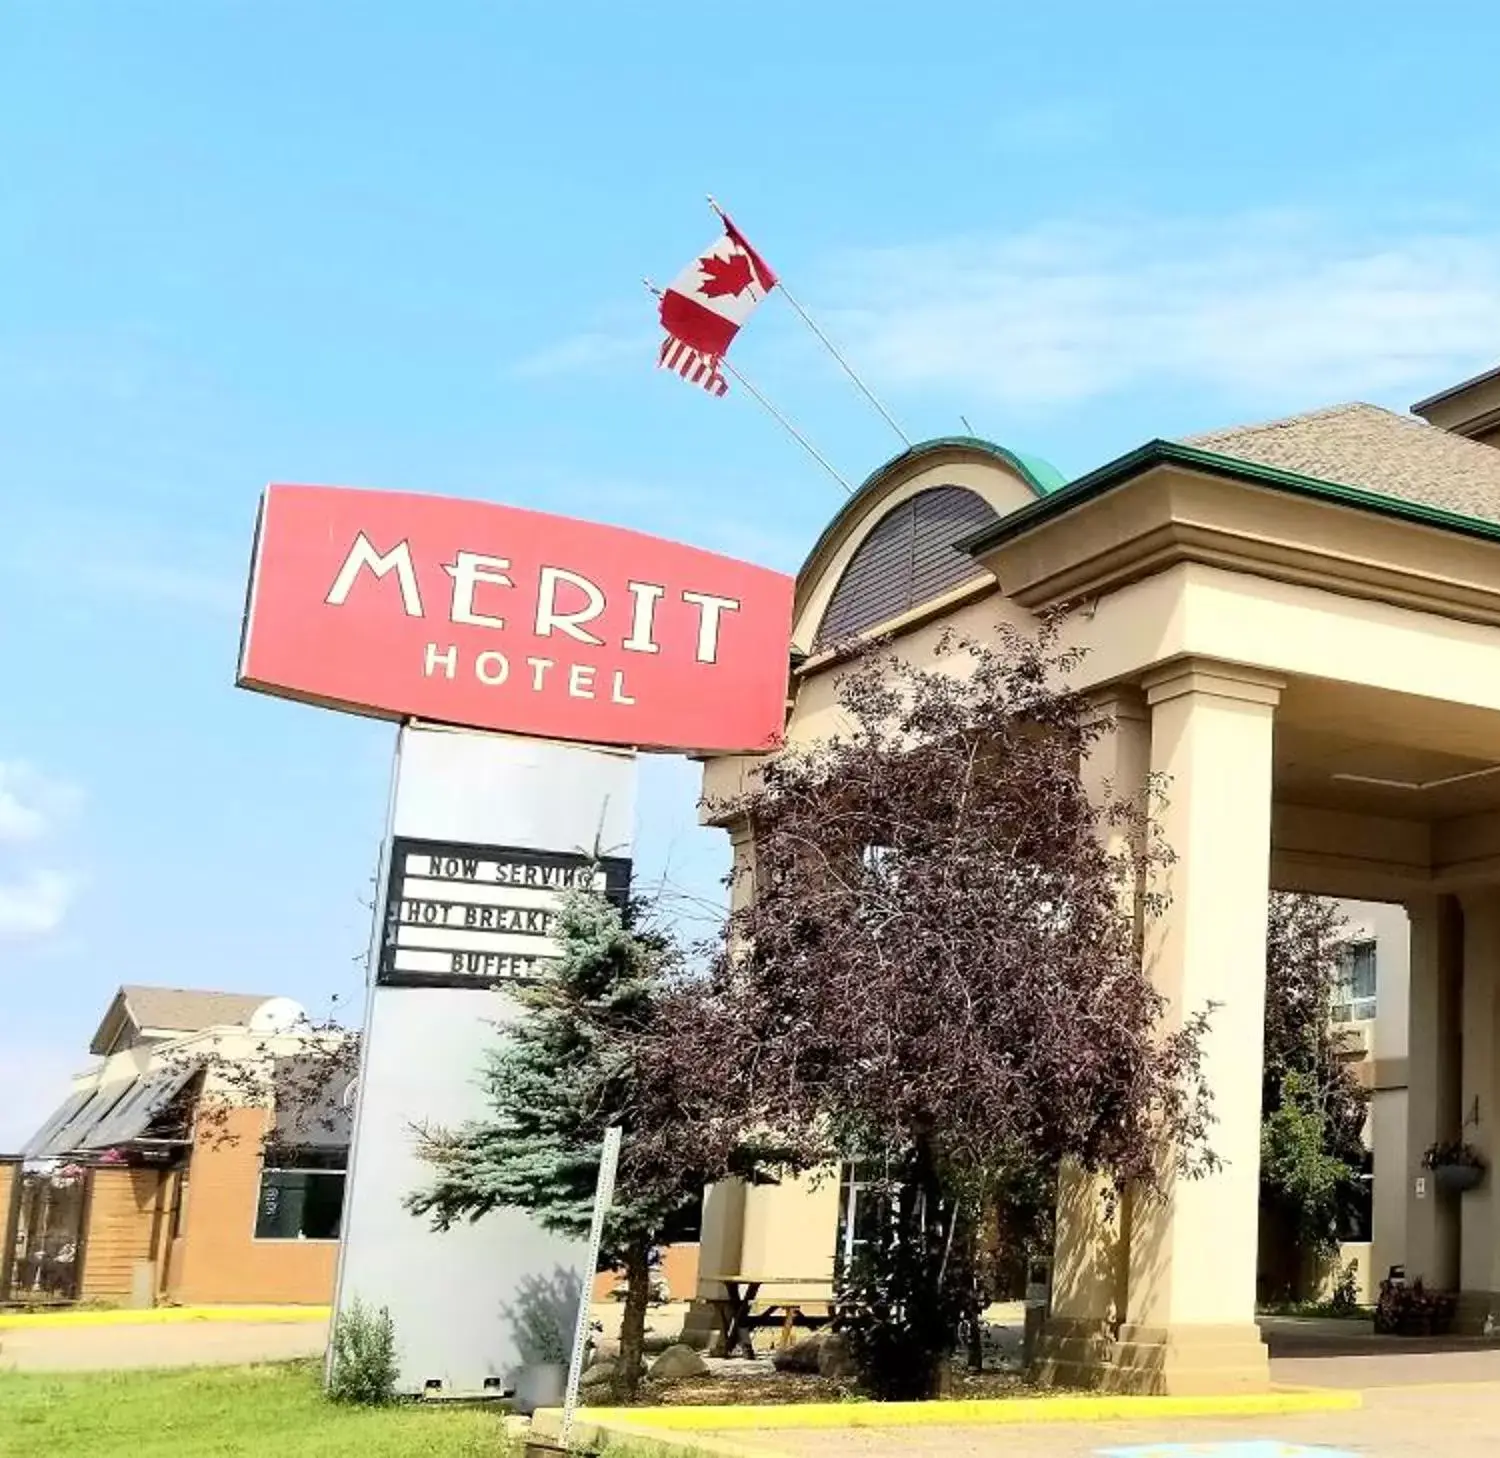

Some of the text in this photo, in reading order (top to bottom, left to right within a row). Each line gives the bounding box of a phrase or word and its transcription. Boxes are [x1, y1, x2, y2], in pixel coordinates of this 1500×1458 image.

[324, 529, 741, 664] MERIT
[423, 642, 636, 706] HOTEL
[428, 855, 479, 880] NOW
[407, 901, 558, 931] HOT BREAKF
